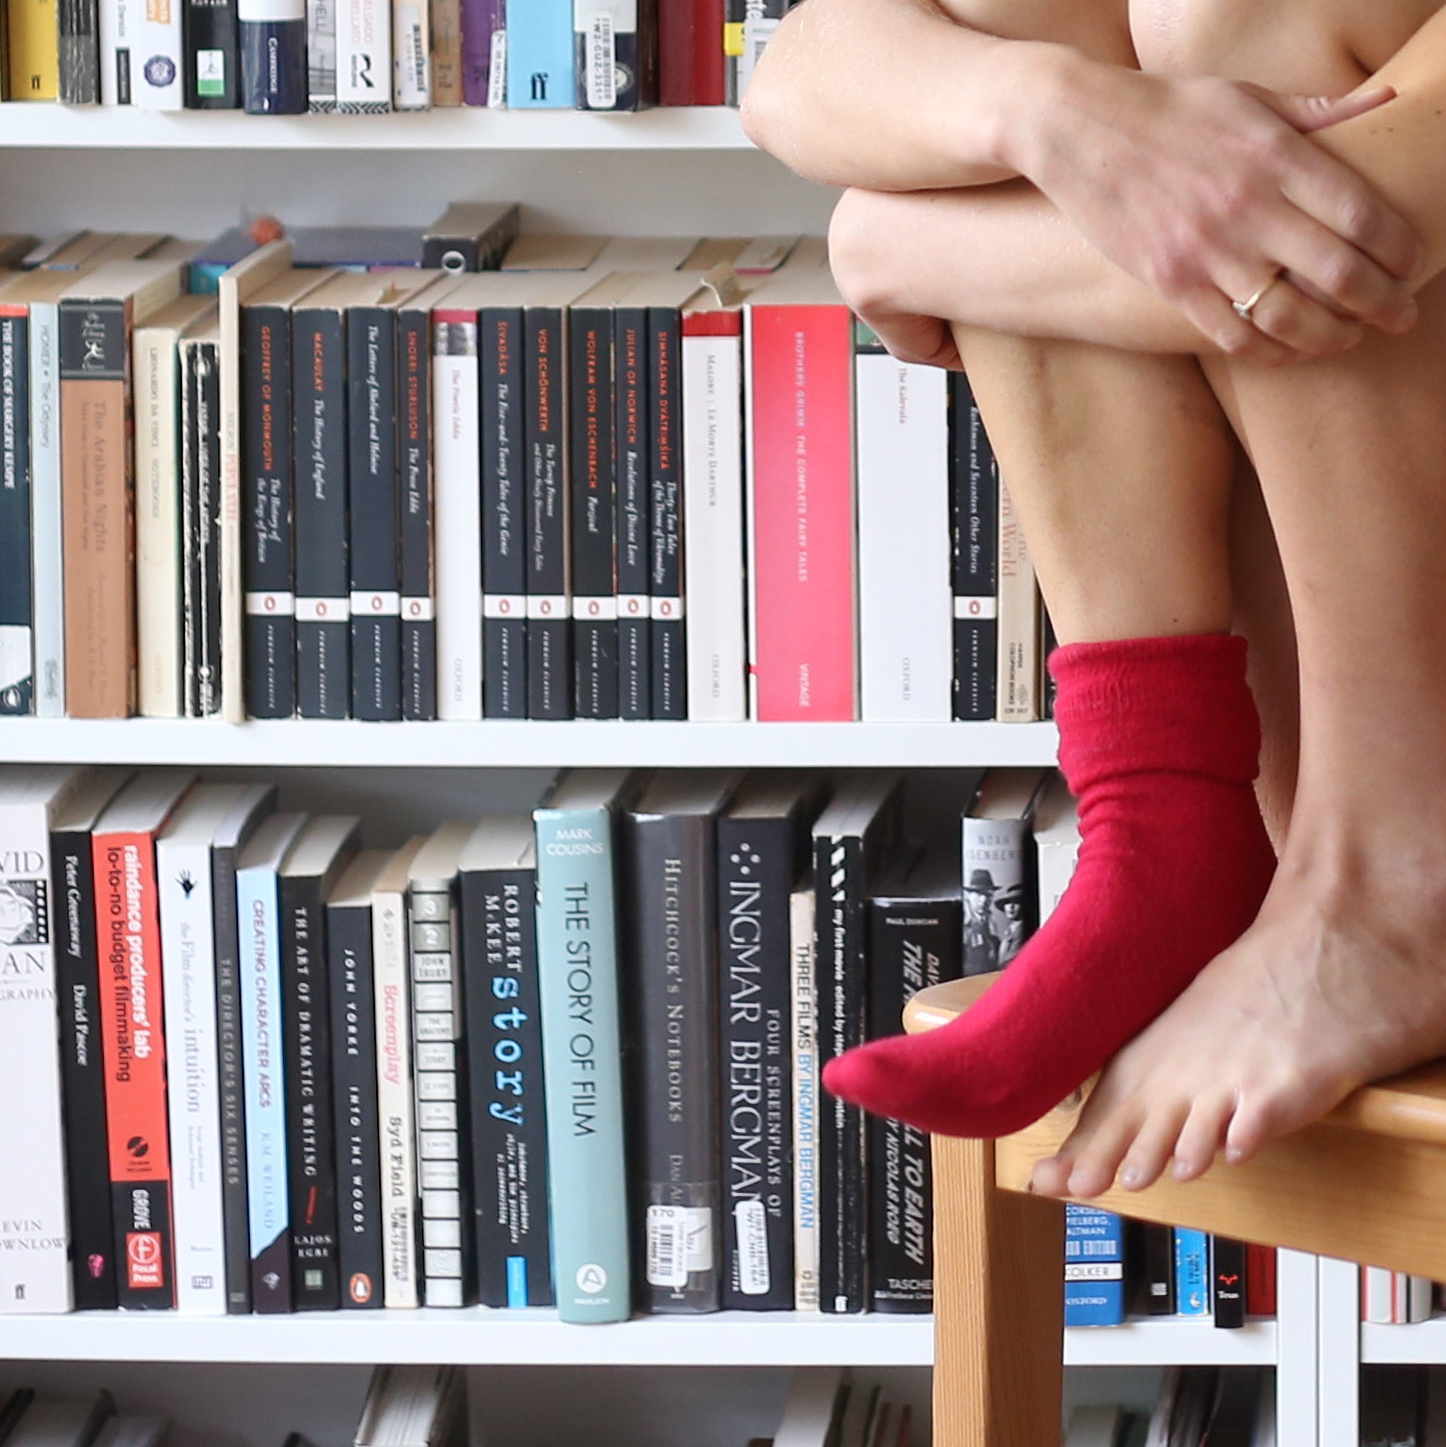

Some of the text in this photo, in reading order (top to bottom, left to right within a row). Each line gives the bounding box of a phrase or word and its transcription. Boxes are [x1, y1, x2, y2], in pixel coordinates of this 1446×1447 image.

[261, 326, 273, 471] GEOFFREY OF MONMOUTH
[313, 332, 324, 391] MACAULAY
[798, 663, 809, 707] VINTAGE
[108, 846, 134, 1083] lo-to-no budget filmmaking
[124, 845, 151, 1058] raindance producers' lab
[503, 884, 522, 973] ROBERT
[730, 881, 761, 1025] INGMAR
[489, 976, 529, 1127] story
[564, 882, 596, 1137] THE STORY OF FILM
[131, 1189, 151, 1229] GROVE
